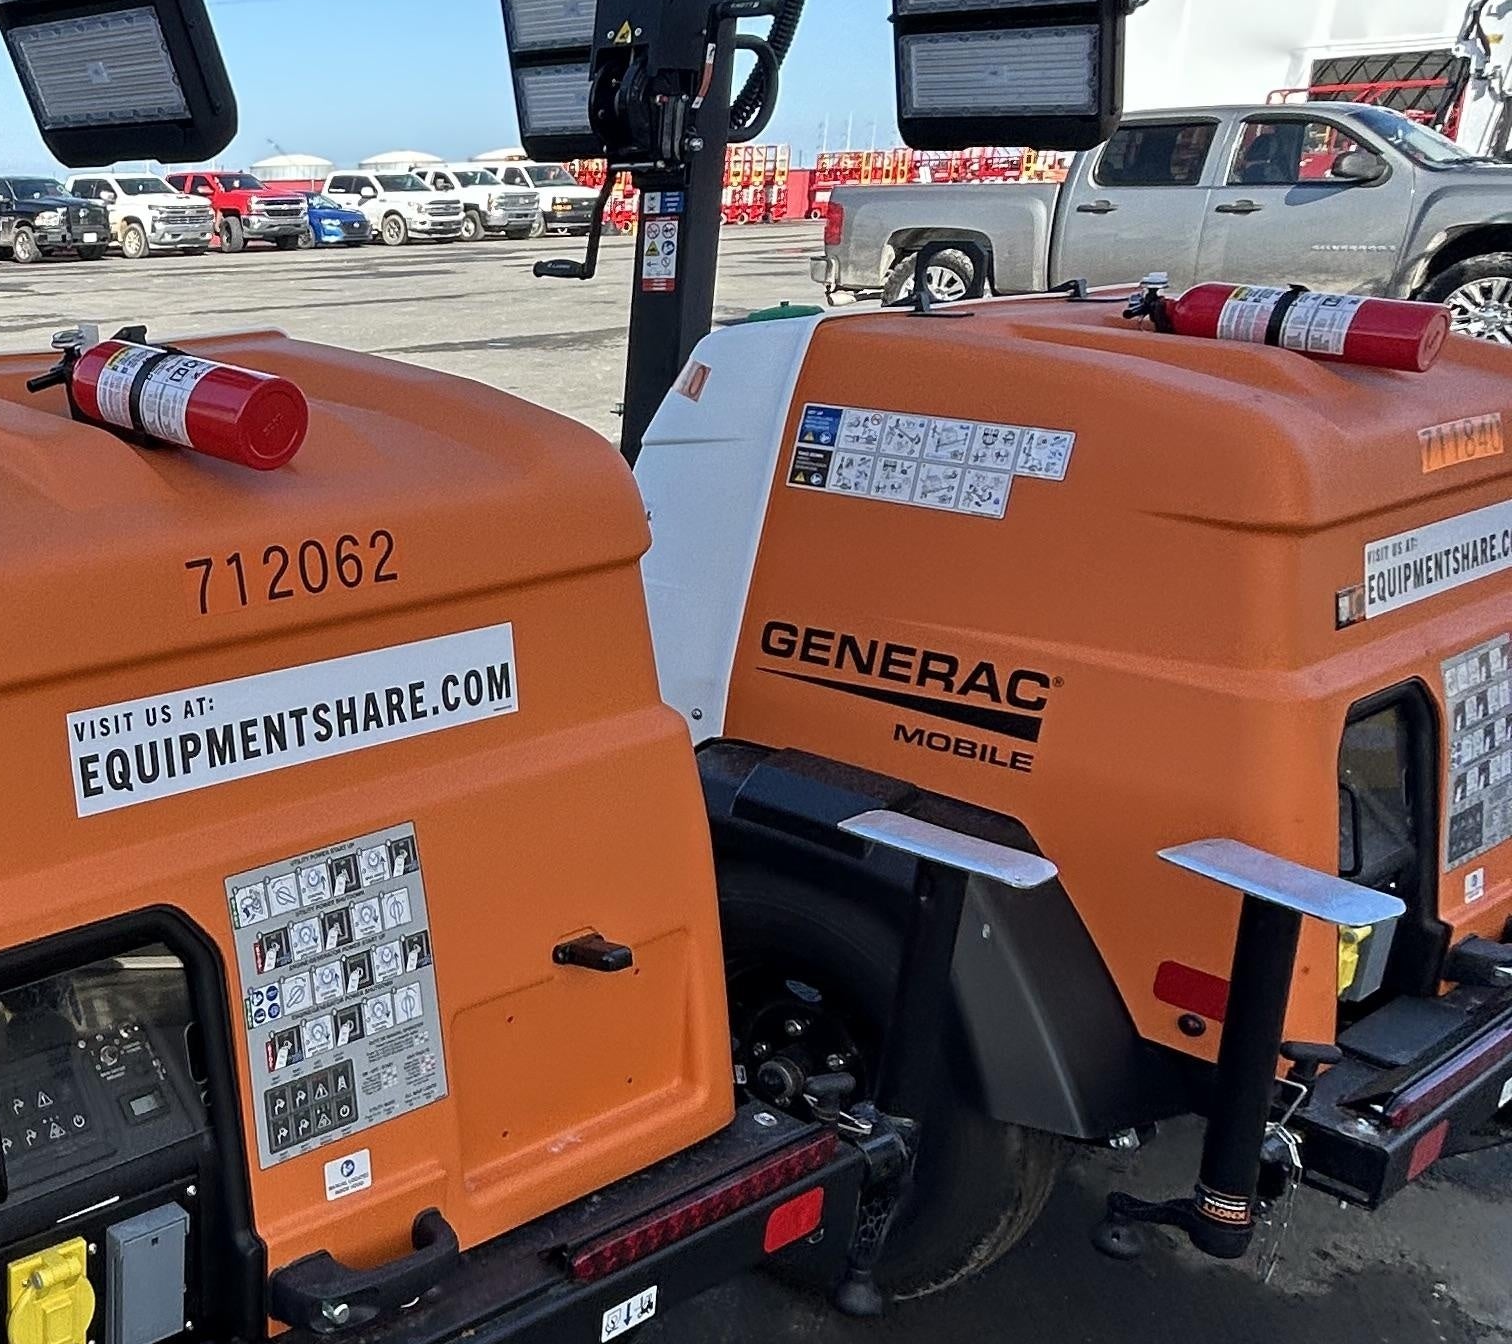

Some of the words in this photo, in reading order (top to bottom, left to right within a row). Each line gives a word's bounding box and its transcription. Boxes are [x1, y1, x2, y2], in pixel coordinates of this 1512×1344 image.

[185, 529, 398, 614] 712062
[1367, 544, 1389, 565] VISIT
[1391, 541, 1402, 556] US
[761, 620, 1051, 711] GENERAC
[73, 711, 134, 742] VISIT
[145, 704, 172, 727] US
[183, 696, 215, 719] AT:
[79, 662, 512, 799] EQUIPMENTSHARE.COM
[893, 723, 1035, 773] MOBILE
